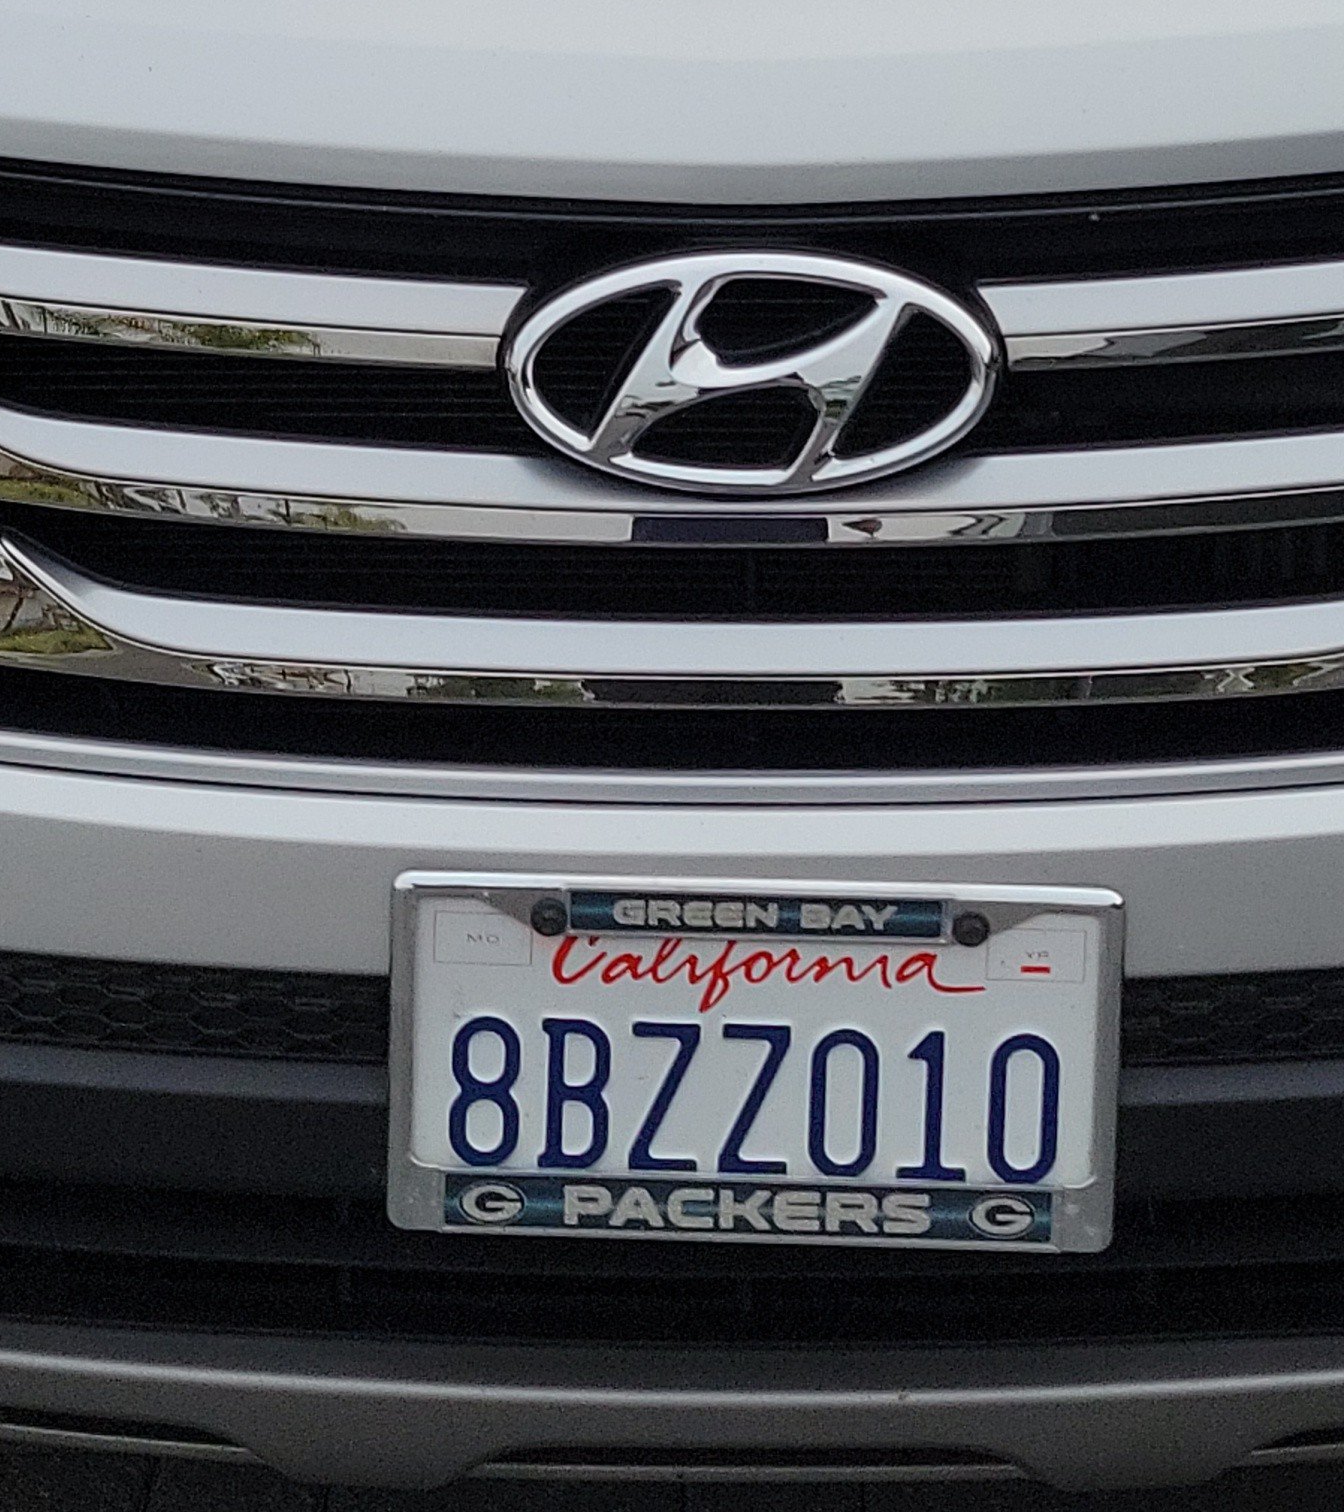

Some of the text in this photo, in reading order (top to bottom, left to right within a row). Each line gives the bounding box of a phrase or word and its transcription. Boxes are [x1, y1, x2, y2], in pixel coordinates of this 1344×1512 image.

[613, 899, 899, 931] GREEN BAY
[551, 934, 986, 1014] California
[448, 1015, 1061, 1185] 8BZZ010
[563, 1185, 931, 1236] PACKERS
